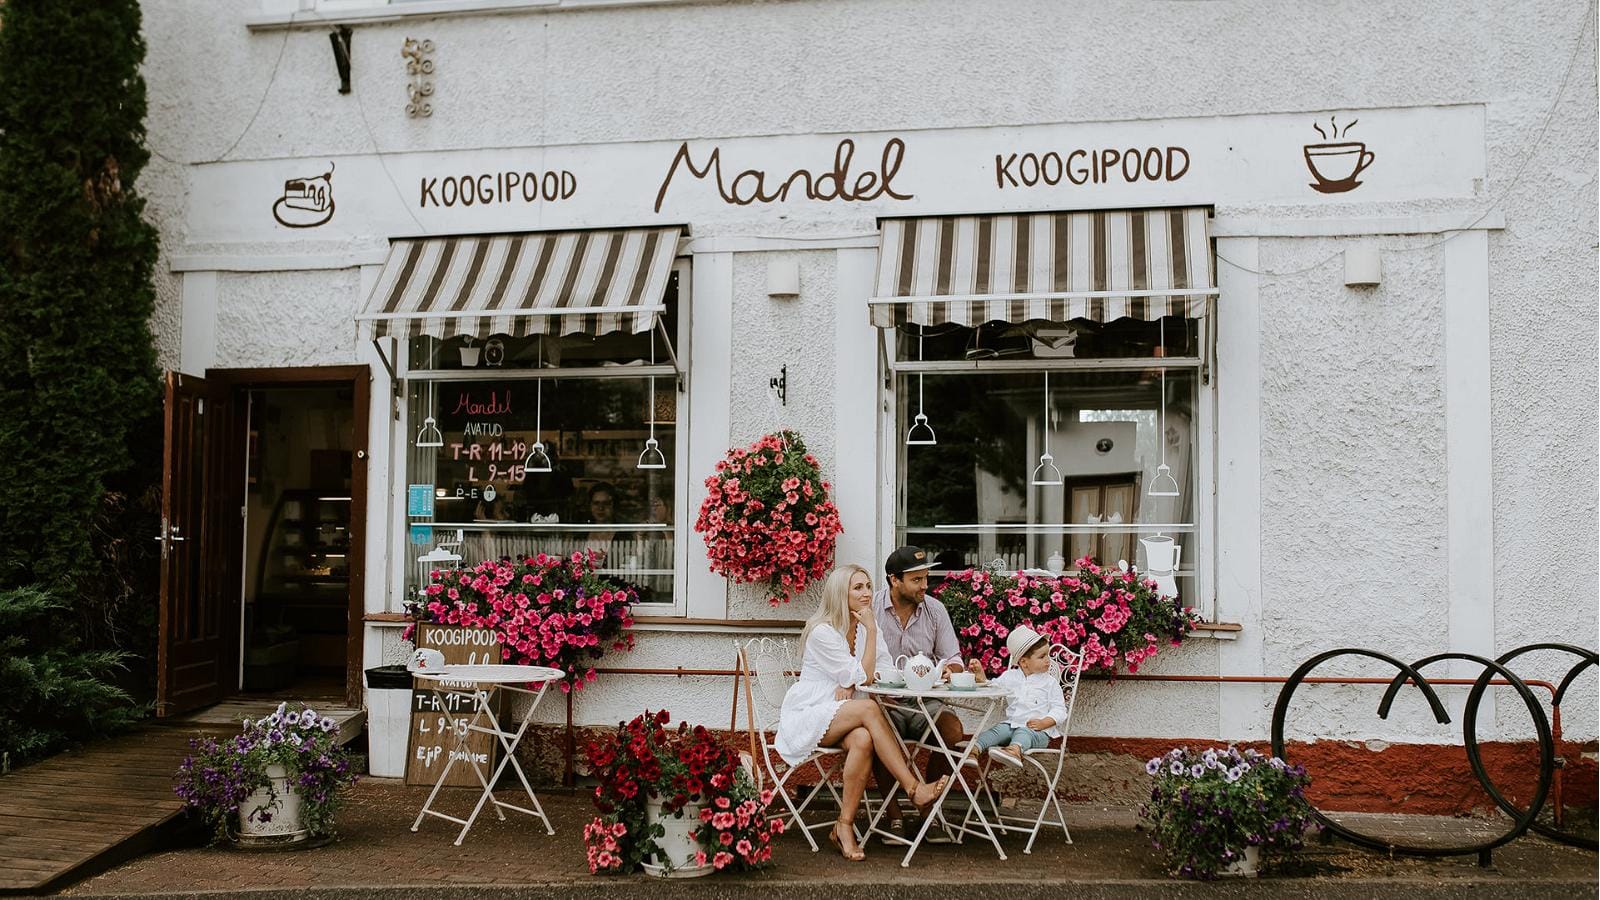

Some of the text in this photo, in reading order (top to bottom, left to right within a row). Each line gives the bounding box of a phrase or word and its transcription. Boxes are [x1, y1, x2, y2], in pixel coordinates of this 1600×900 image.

[420, 138, 1191, 213] KOOGIPOOD Mandel KOOGIPOOD
[452, 390, 512, 415] Mandel
[463, 422, 503, 437] AVATUD
[450, 442, 526, 461] T-R 11-19
[468, 464, 526, 482] L 9-15
[426, 629, 497, 646] KOOGIPOOD
[415, 694, 440, 711] T-R
[420, 717, 469, 736] L 9-15
